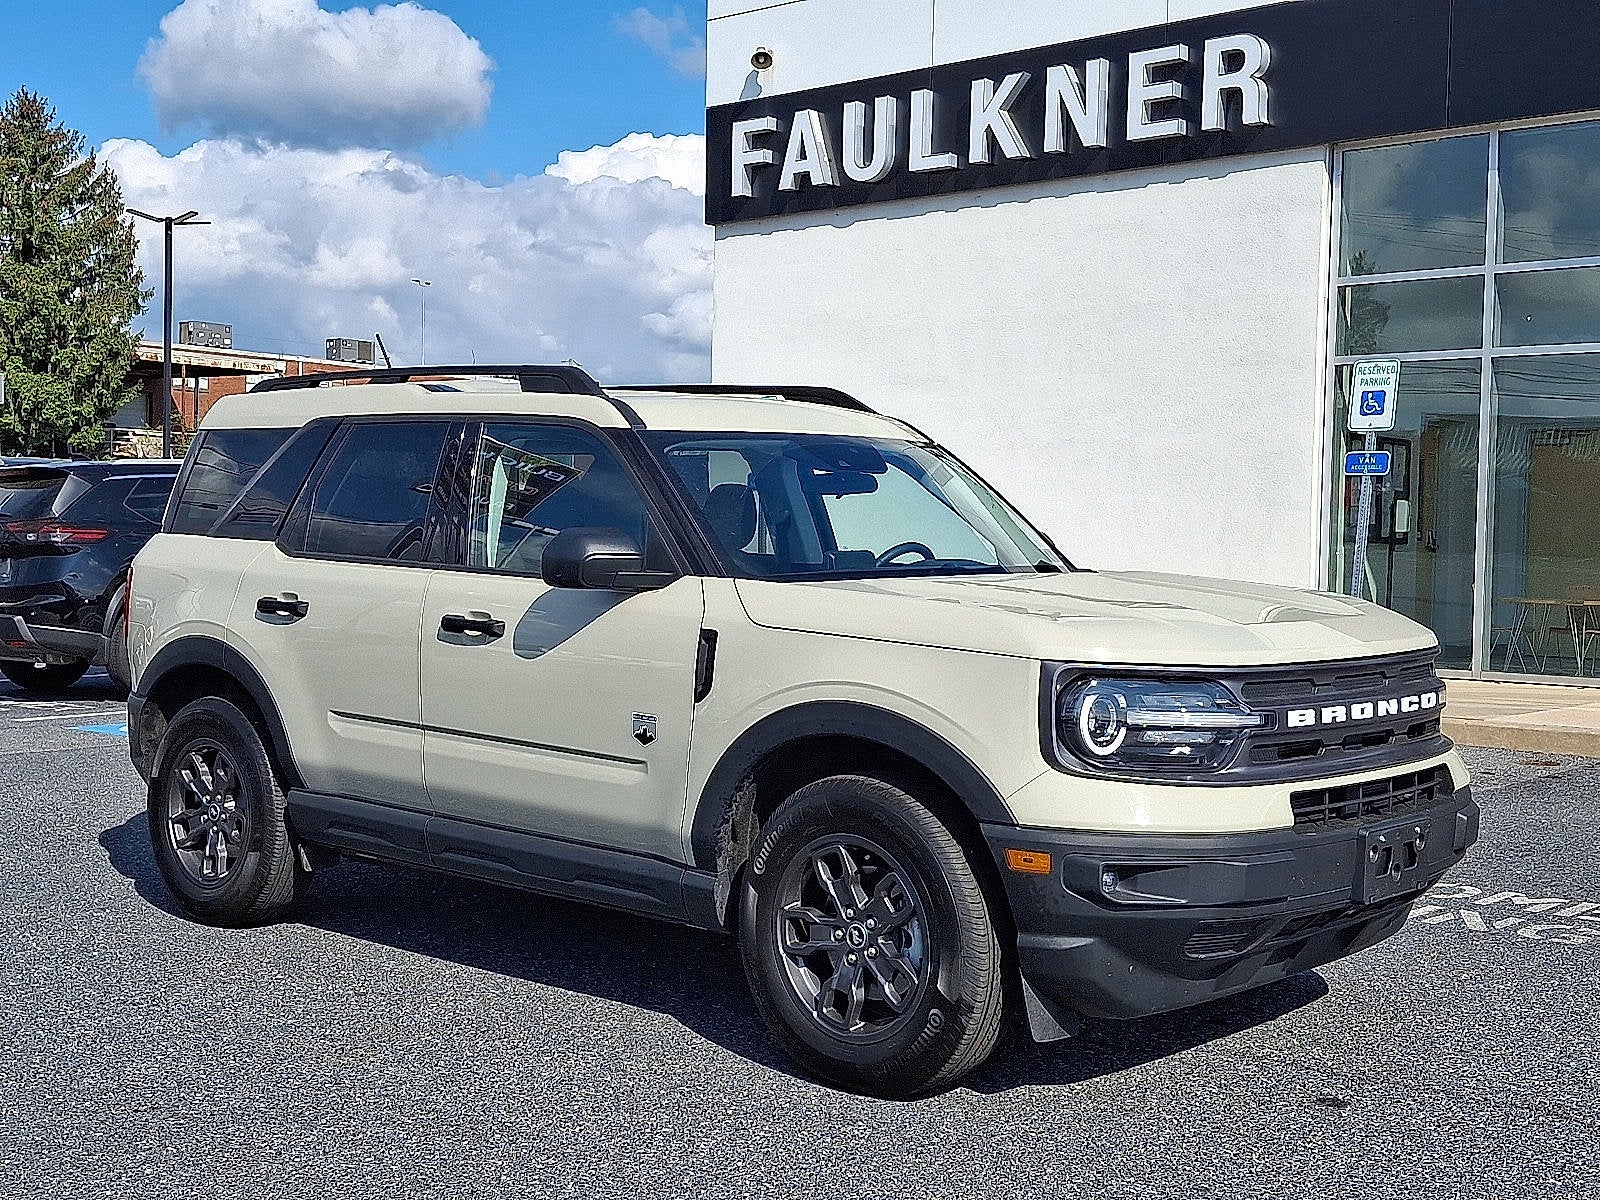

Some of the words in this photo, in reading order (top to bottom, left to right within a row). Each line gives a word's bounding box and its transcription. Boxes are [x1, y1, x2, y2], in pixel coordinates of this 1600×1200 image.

[731, 32, 1272, 198] FAULKNER
[1357, 364, 1396, 376] RESERVED
[1359, 376, 1391, 387] PARKING
[1358, 455, 1377, 464] VAN
[1287, 691, 1437, 728] BRONCO
